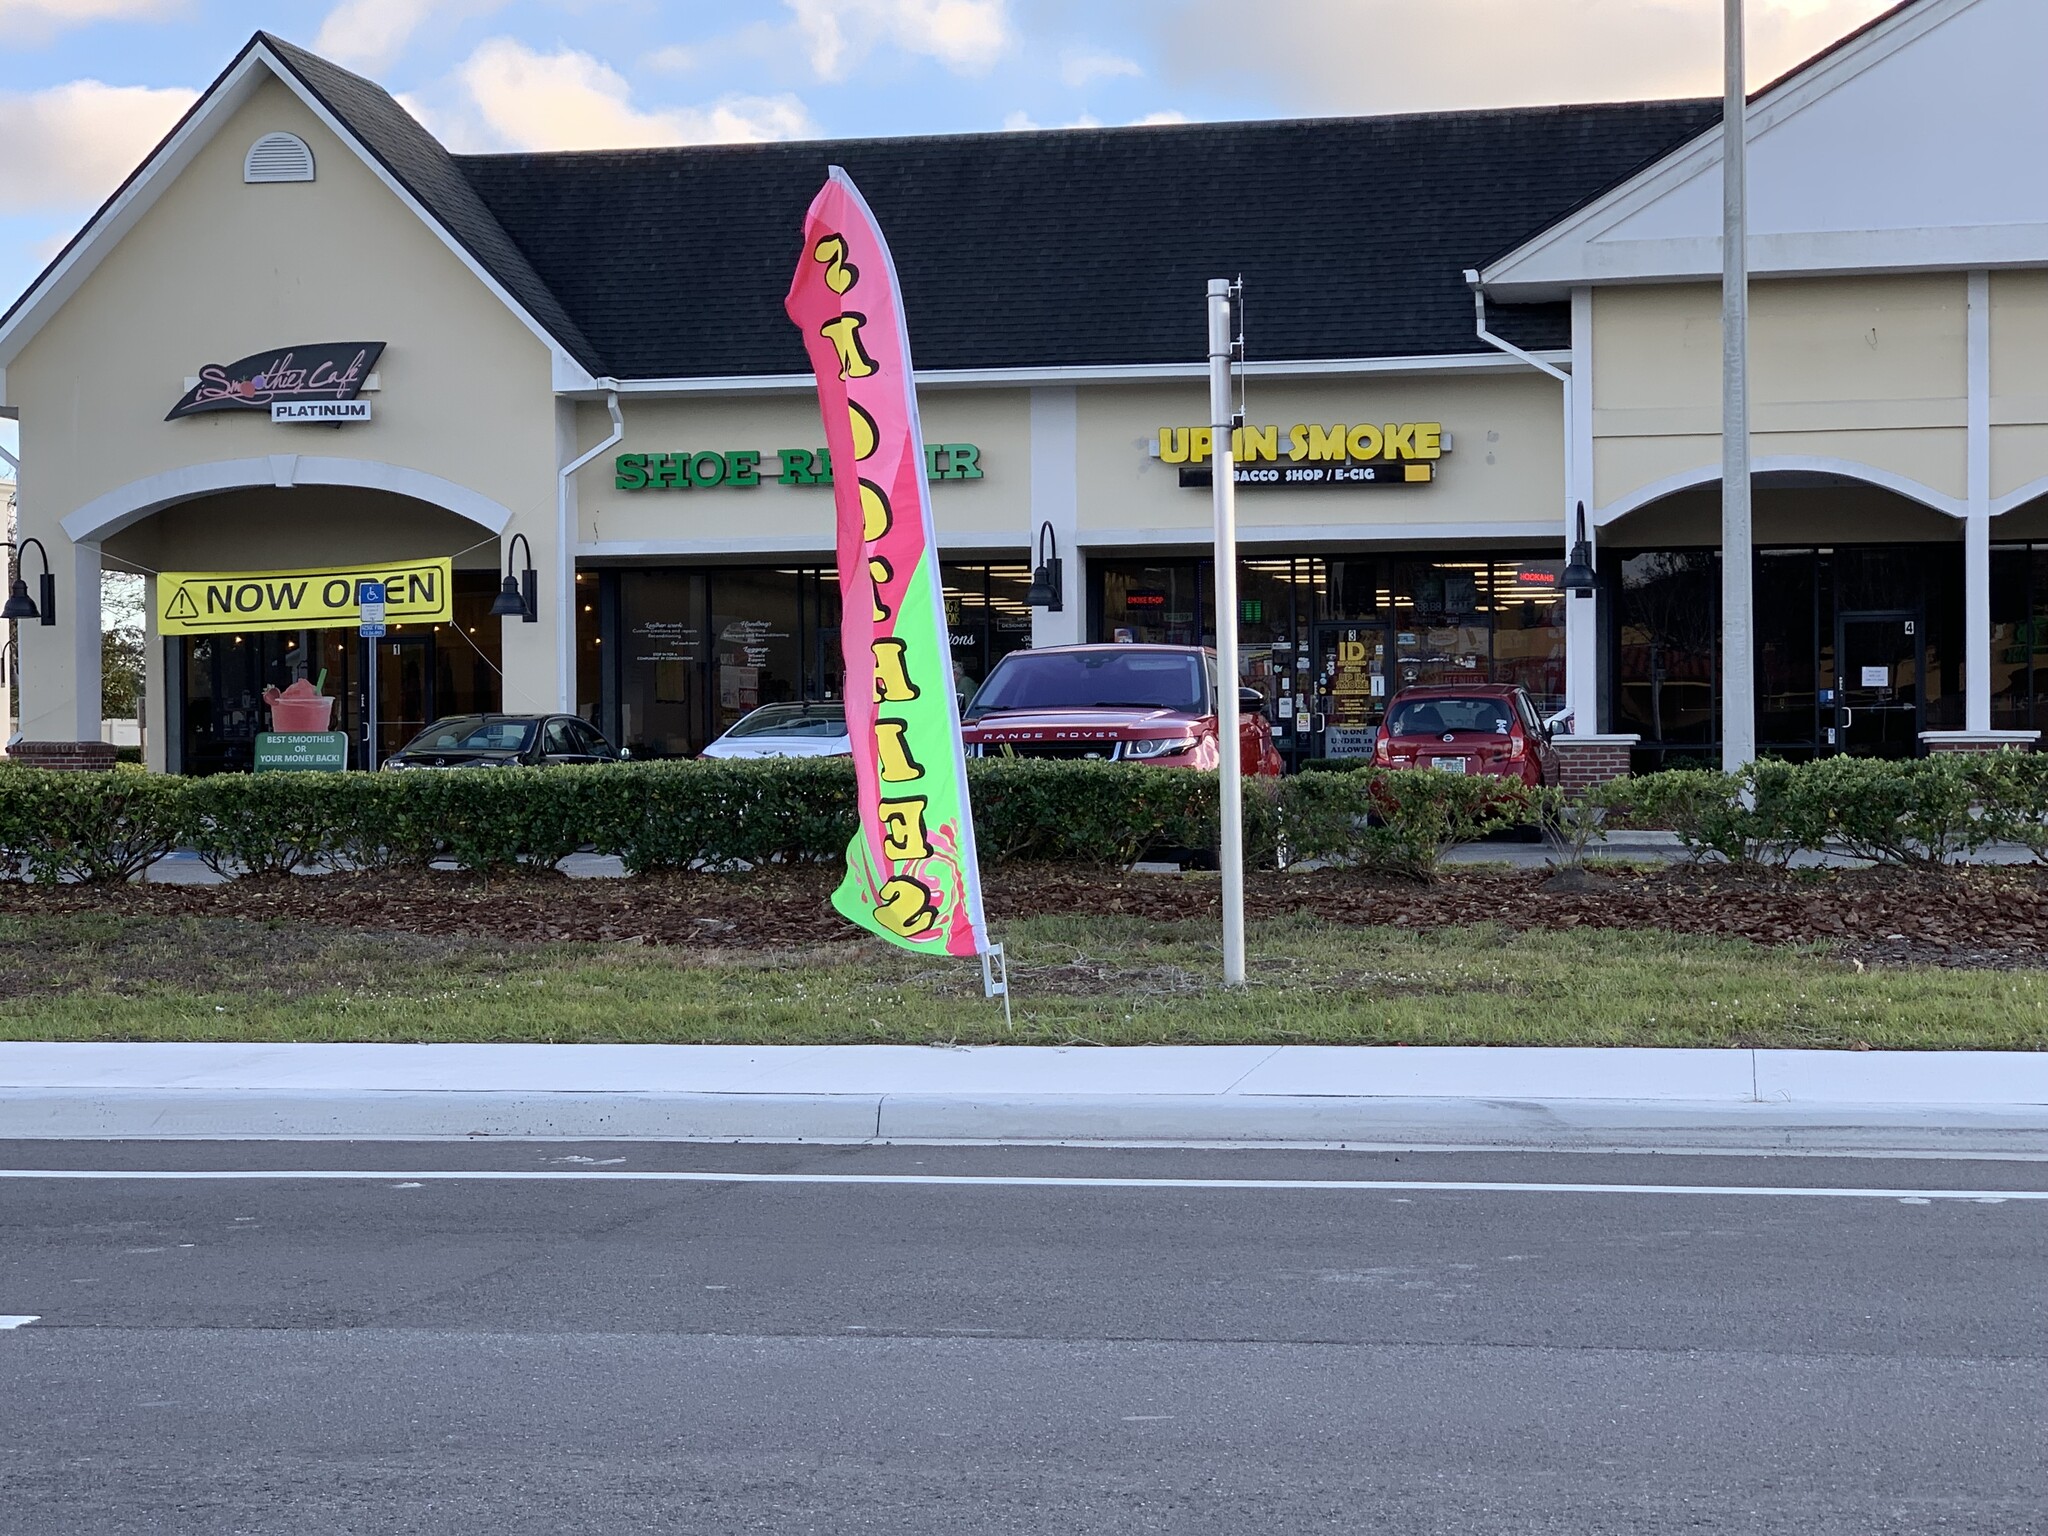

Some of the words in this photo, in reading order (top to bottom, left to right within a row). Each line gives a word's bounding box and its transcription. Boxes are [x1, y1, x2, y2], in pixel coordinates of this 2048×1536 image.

[276, 404, 366, 417] PLATINUM
[1158, 427, 1213, 463] UP
[1231, 424, 1278, 461] IN
[1288, 422, 1441, 460] SMOKE
[615, 450, 761, 490] SHOE
[777, 443, 984, 485] RIR
[1232, 469, 1279, 482] BACCO
[1285, 469, 1323, 481] SHOP
[1335, 468, 1375, 480] E-CIG
[1519, 572, 1555, 582] HOOKAHS
[207, 581, 308, 614] NOW
[1906, 622, 1913, 633] 4
[1349, 630, 1355, 640] 3
[1339, 641, 1366, 661] ID
[1338, 673, 1354, 681] UP
[1354, 672, 1366, 681] IN
[1335, 680, 1369, 689] SMOKE
[267, 736, 286, 744] BEST
[287, 735, 335, 743] SMOOTHIES
[315, 754, 340, 762] BACK!
